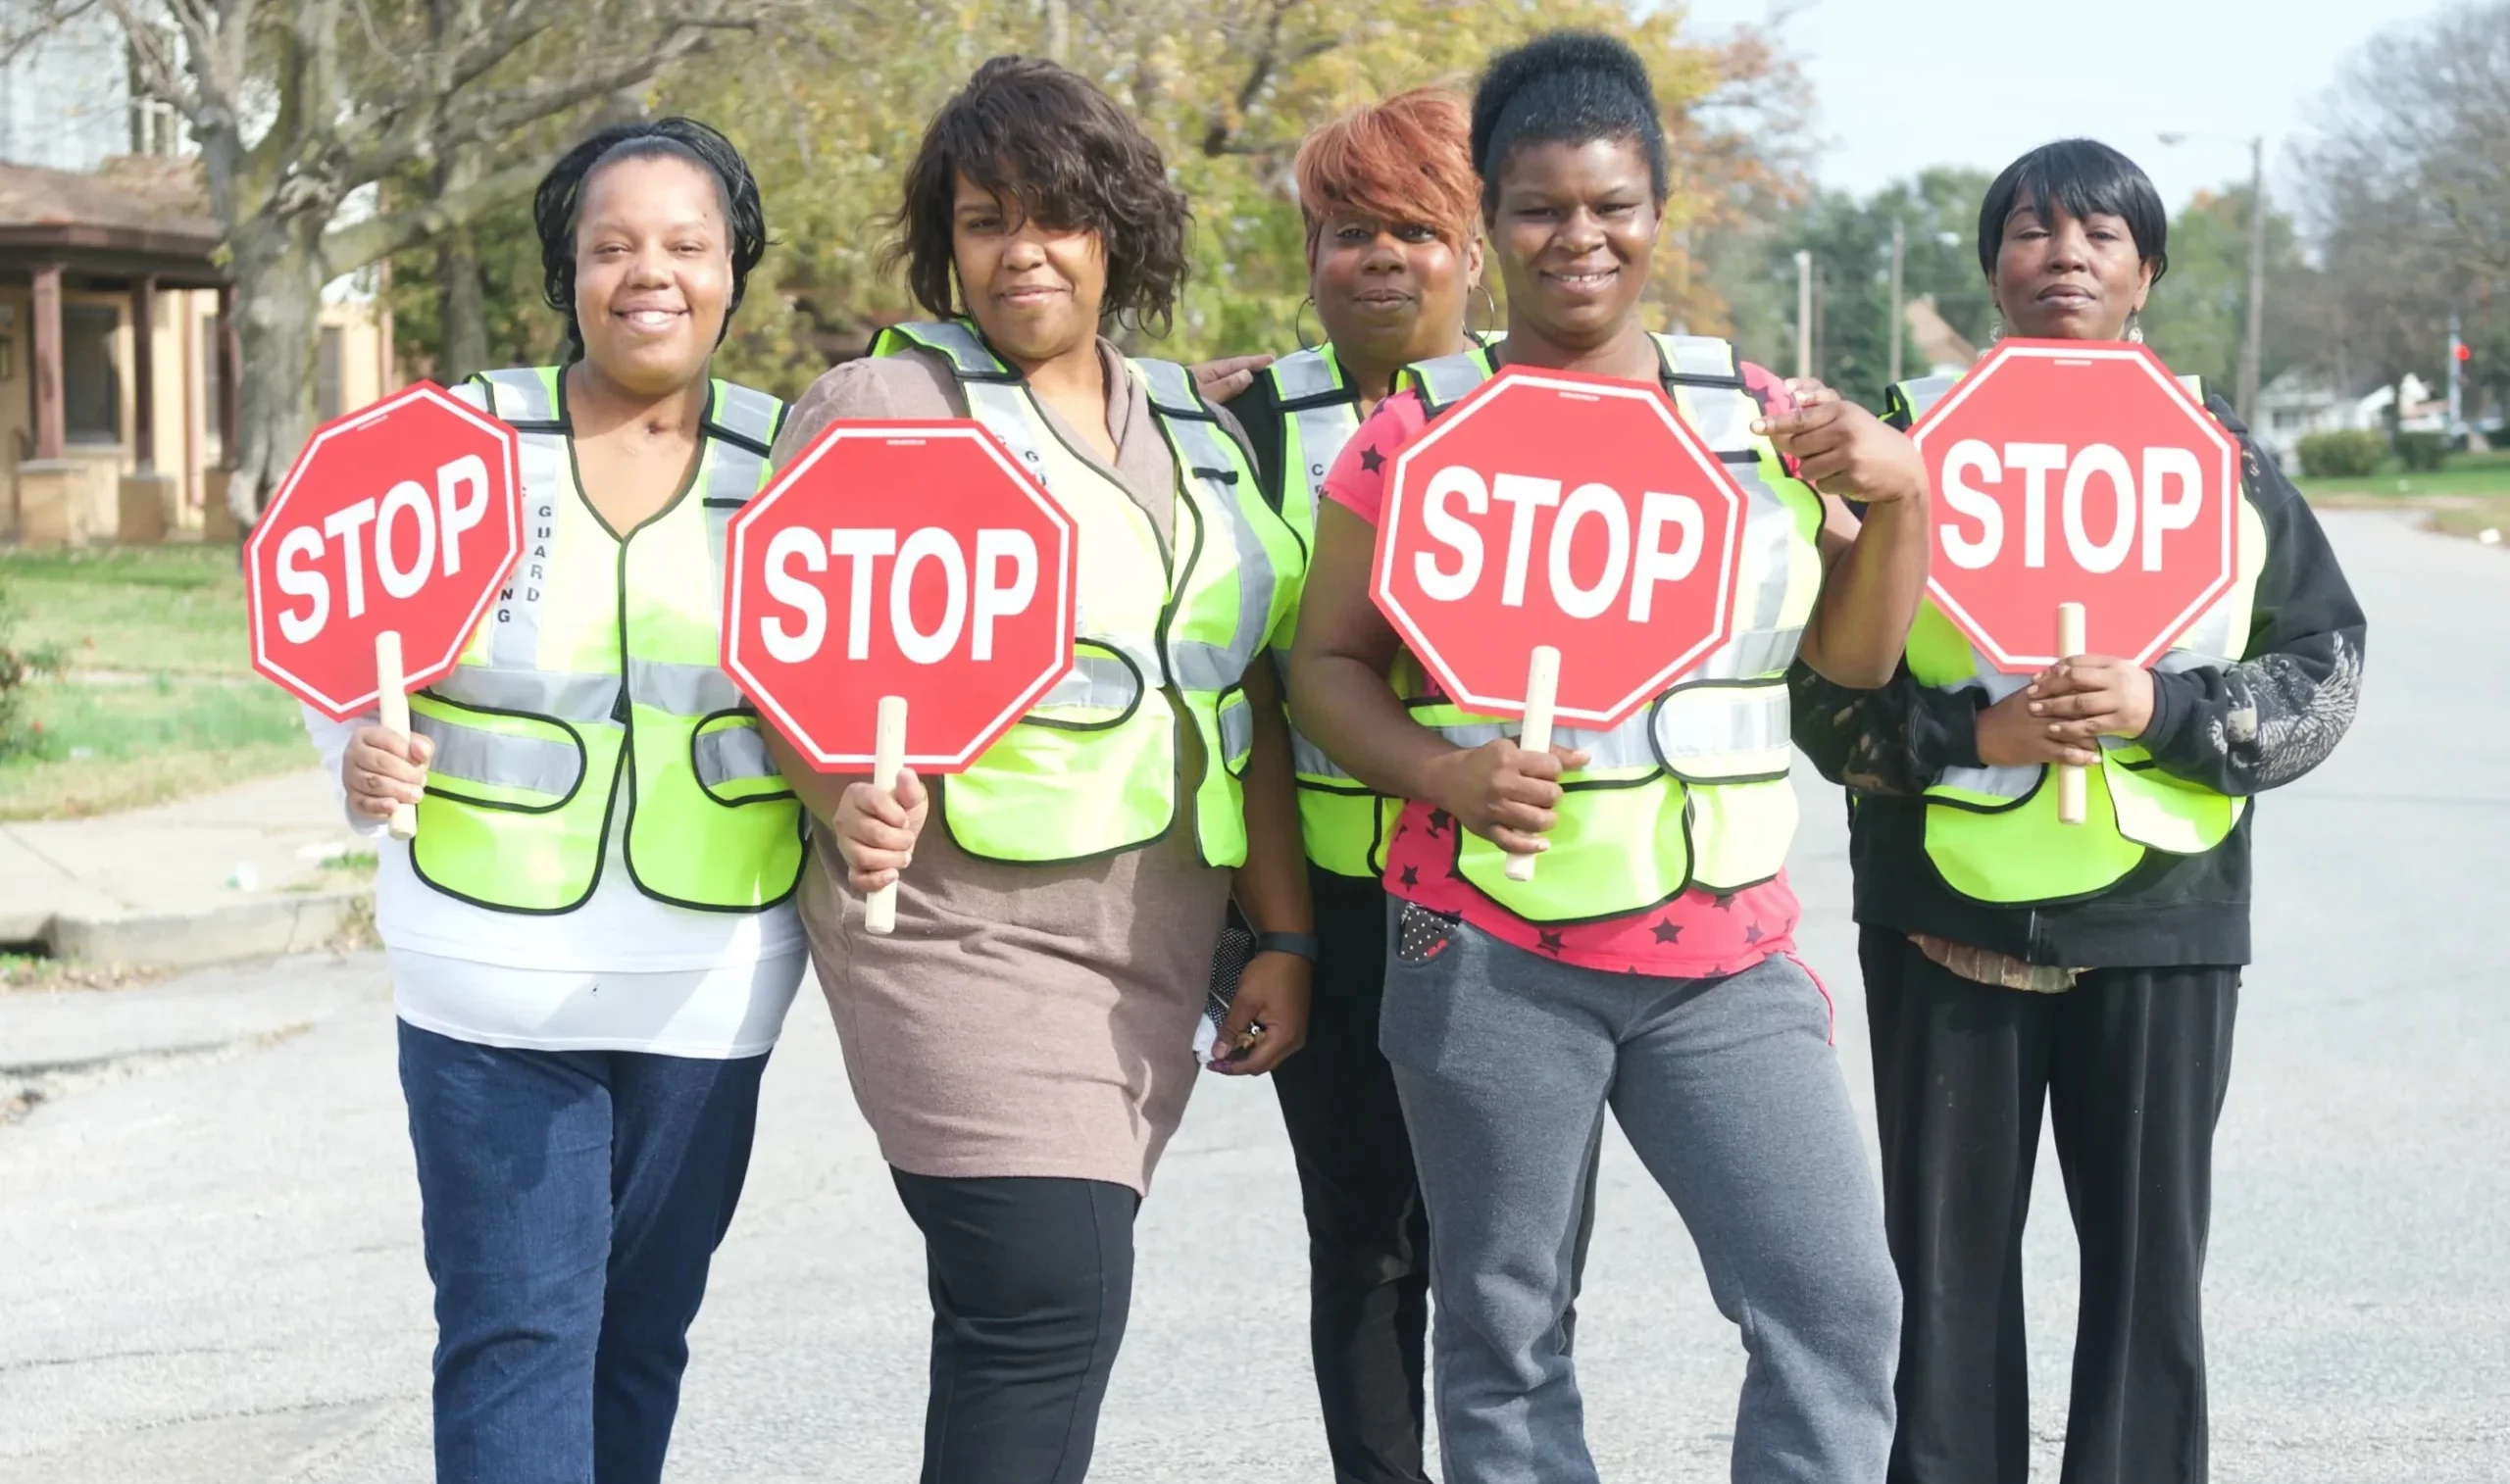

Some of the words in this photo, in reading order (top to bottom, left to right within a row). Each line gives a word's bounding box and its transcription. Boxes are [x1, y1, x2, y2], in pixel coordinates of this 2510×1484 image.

[276, 454, 489, 644] STOP
[526, 505, 552, 603] GUARD
[1414, 466, 1705, 623] STOP
[1939, 438, 2203, 574] STOP
[760, 526, 1038, 665] STOP
